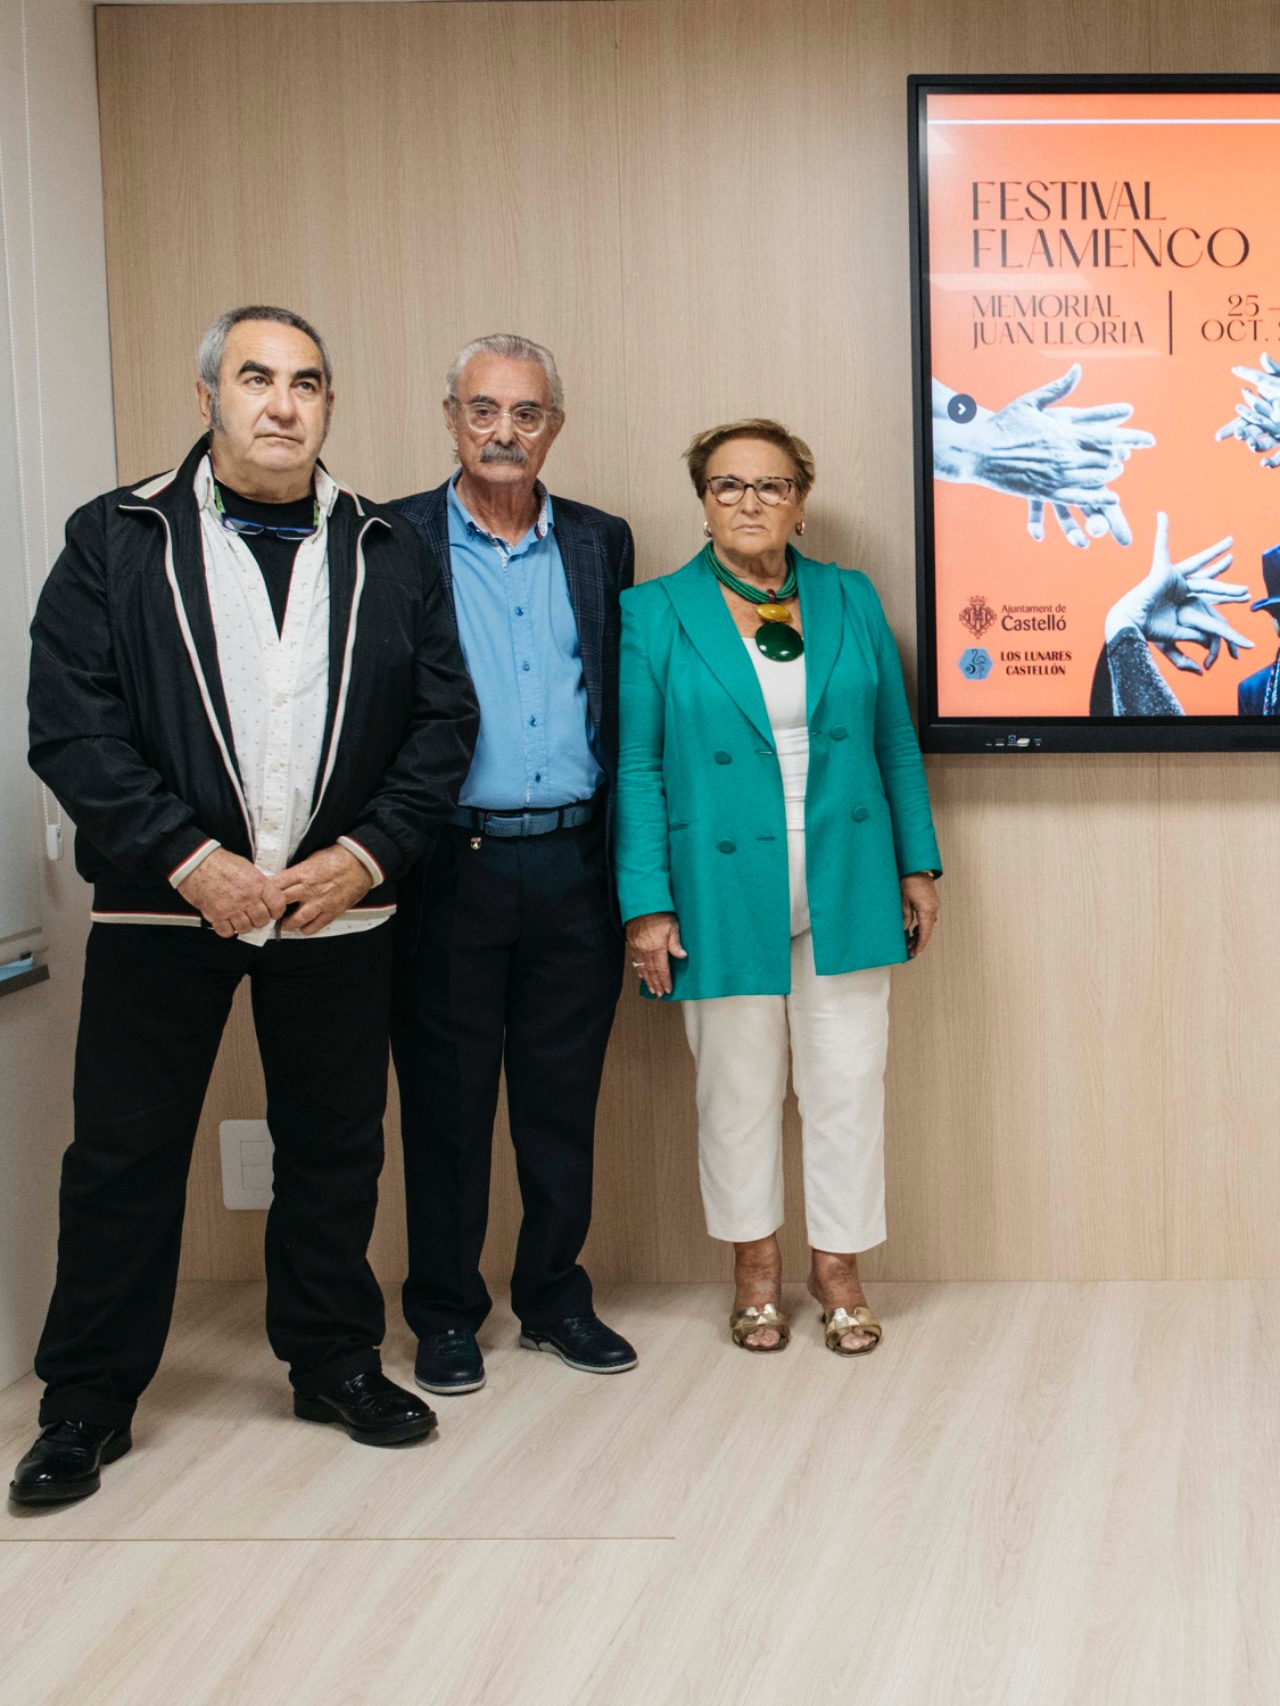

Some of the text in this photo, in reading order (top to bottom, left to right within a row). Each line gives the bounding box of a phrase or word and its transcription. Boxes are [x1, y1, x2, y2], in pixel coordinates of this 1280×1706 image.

[972, 181, 1167, 222] FESTIVAL
[972, 227, 1249, 268] FLAMENCO
[973, 294, 1120, 318] MEMORIAL
[1228, 294, 1260, 317] 25
[973, 321, 1144, 349] JUAN LLORIA
[1201, 319, 1268, 342] OCT.
[1001, 604, 1066, 615] Ajuntament de
[1001, 614, 1067, 631] Castelló
[1000, 651, 1072, 661] LOS LUNARES
[1006, 662, 1066, 676] CASTELLÓN
